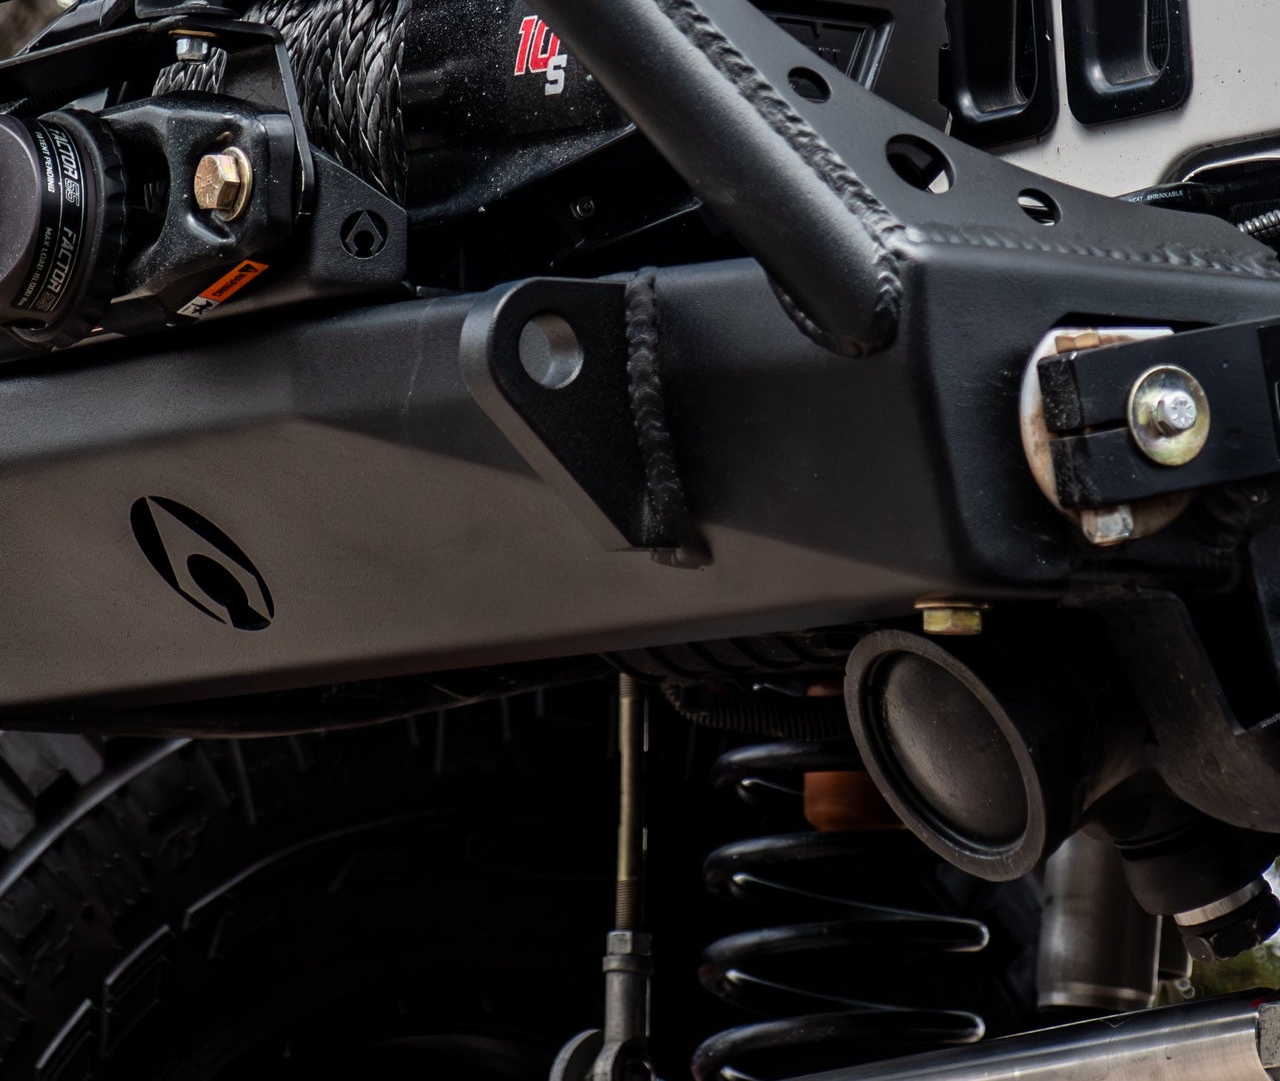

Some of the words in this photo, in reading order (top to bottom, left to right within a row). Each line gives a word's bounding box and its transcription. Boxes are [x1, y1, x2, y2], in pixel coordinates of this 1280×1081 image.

[35, 131, 50, 156] PATENT
[44, 156, 55, 194] PENDING
[49, 128, 79, 180] FACTOR
[64, 178, 81, 207] 55
[47, 226, 77, 293] FACTOR
